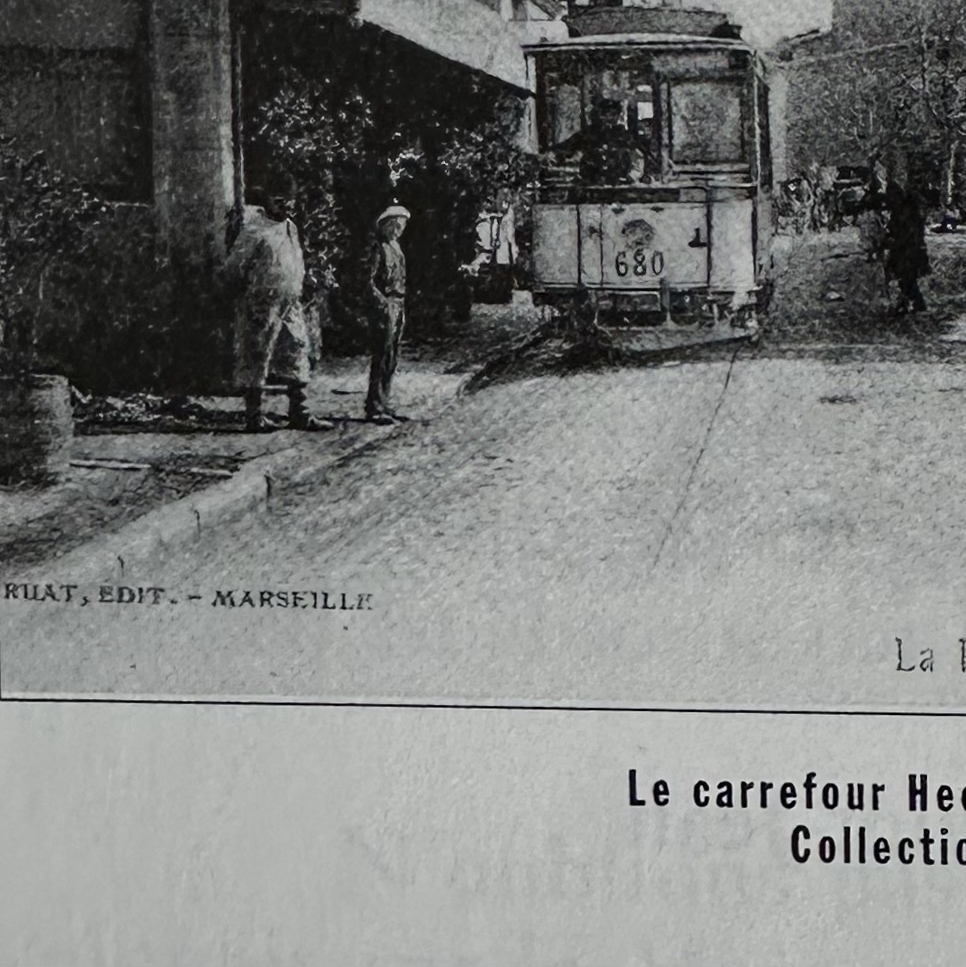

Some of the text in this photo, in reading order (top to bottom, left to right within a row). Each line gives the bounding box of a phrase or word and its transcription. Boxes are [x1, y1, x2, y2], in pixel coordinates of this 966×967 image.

[615, 249, 664, 277] 680
[895, 637, 934, 673] La
[628, 768, 670, 807] Le
[693, 771, 886, 811] carrefour
